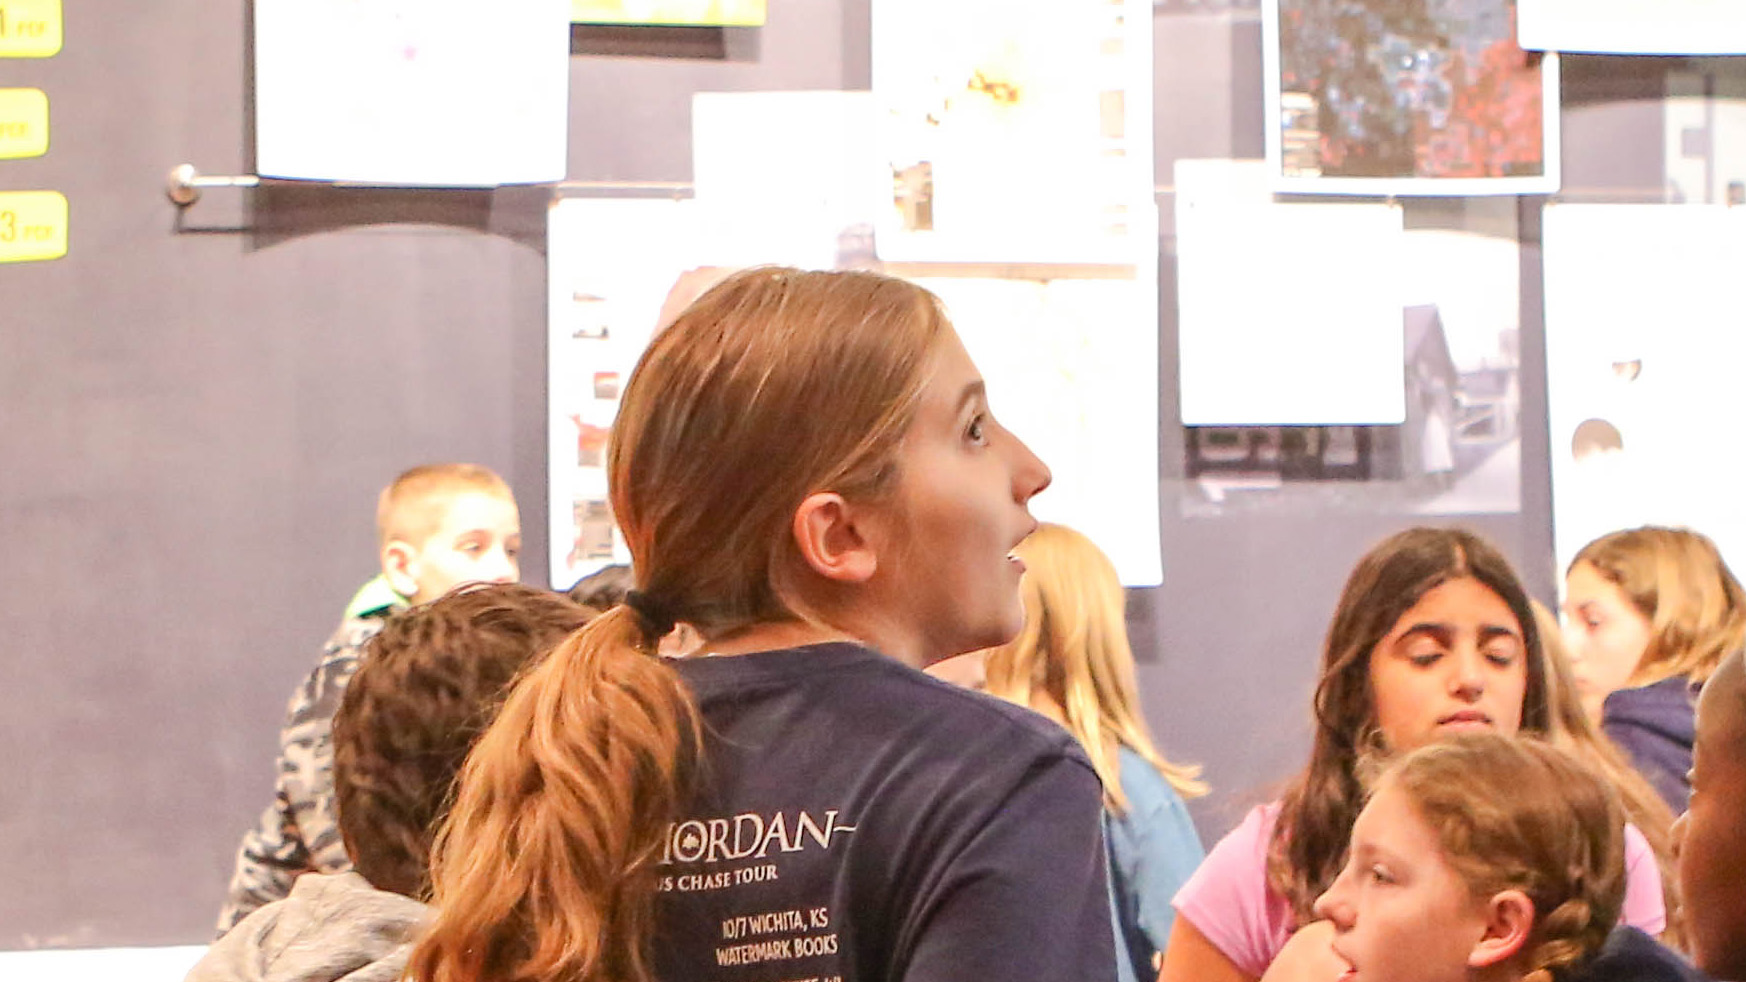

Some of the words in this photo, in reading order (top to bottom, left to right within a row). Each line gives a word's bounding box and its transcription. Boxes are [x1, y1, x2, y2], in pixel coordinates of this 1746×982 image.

[677, 871, 731, 892] CHASE
[735, 865, 779, 886] TOUR
[722, 917, 747, 939] 10/7
[750, 910, 808, 935] WICHITA,
[810, 907, 828, 928] KS
[716, 940, 792, 966] WATERMARK
[794, 933, 838, 958] BOOKS
